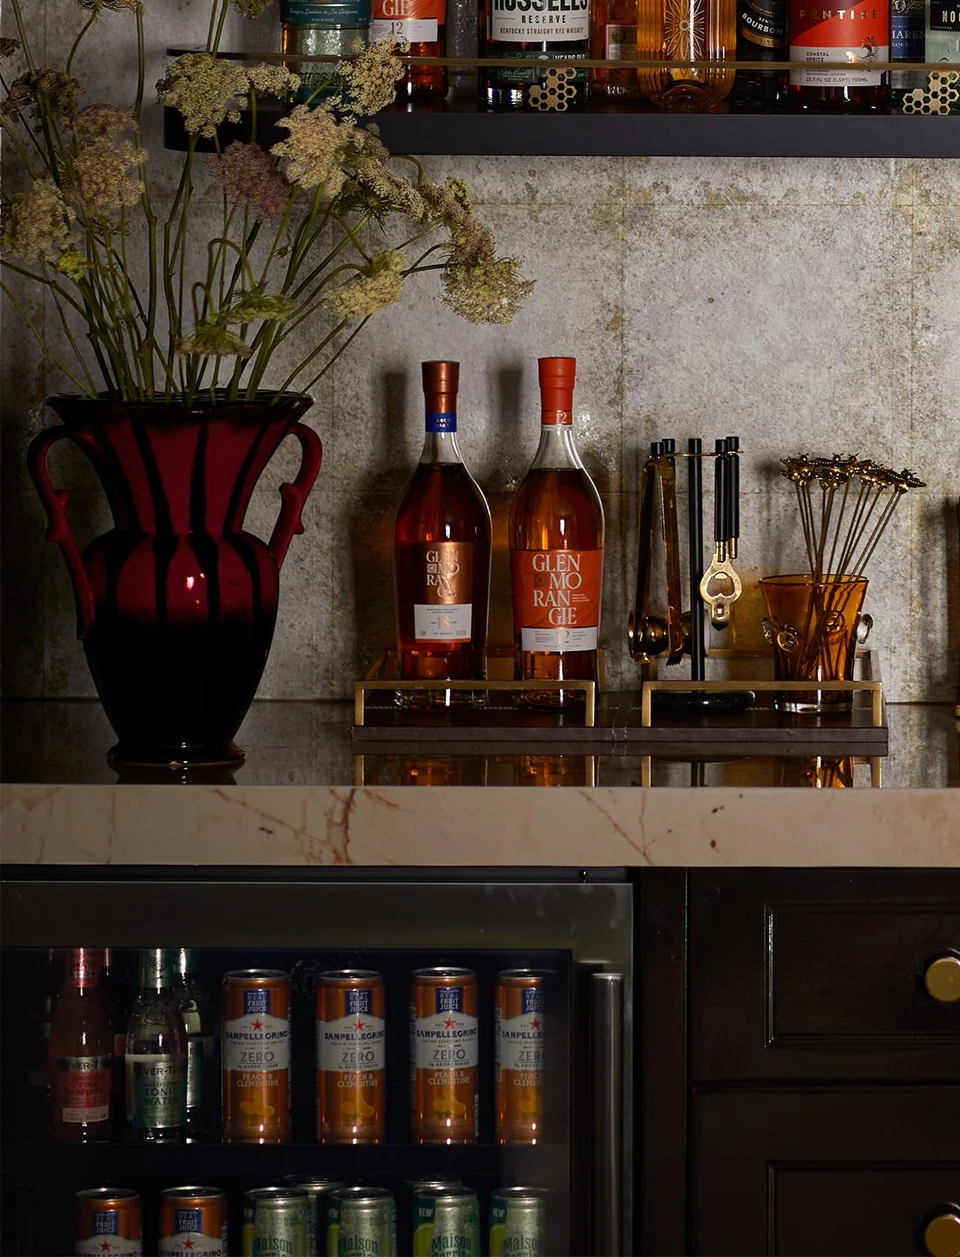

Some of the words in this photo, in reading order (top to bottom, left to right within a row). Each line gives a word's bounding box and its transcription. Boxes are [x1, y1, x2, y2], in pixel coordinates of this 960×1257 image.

[521, 14, 567, 24] RESERVE
[800, 9, 879, 20] PENTIRE
[391, 21, 404, 35] 12
[741, 13, 784, 36] BOURBON
[500, 27, 525, 35] KENTUCKY
[526, 27, 554, 35] STRAIGHT
[556, 412, 567, 424] 12
[426, 551, 459, 563] GLEN
[532, 553, 581, 572] GLEN
[549, 572, 582, 590] MO
[533, 590, 571, 607] RAN
[548, 607, 577, 626] GIE
[225, 1031, 288, 1040] SANPELLEGRINO
[241, 1051, 275, 1062] ZERO
[342, 1051, 374, 1063] ZERO
[433, 1049, 466, 1060] ZERO
[418, 1207, 433, 1217] NEW
[432, 1233, 472, 1252] Maison
